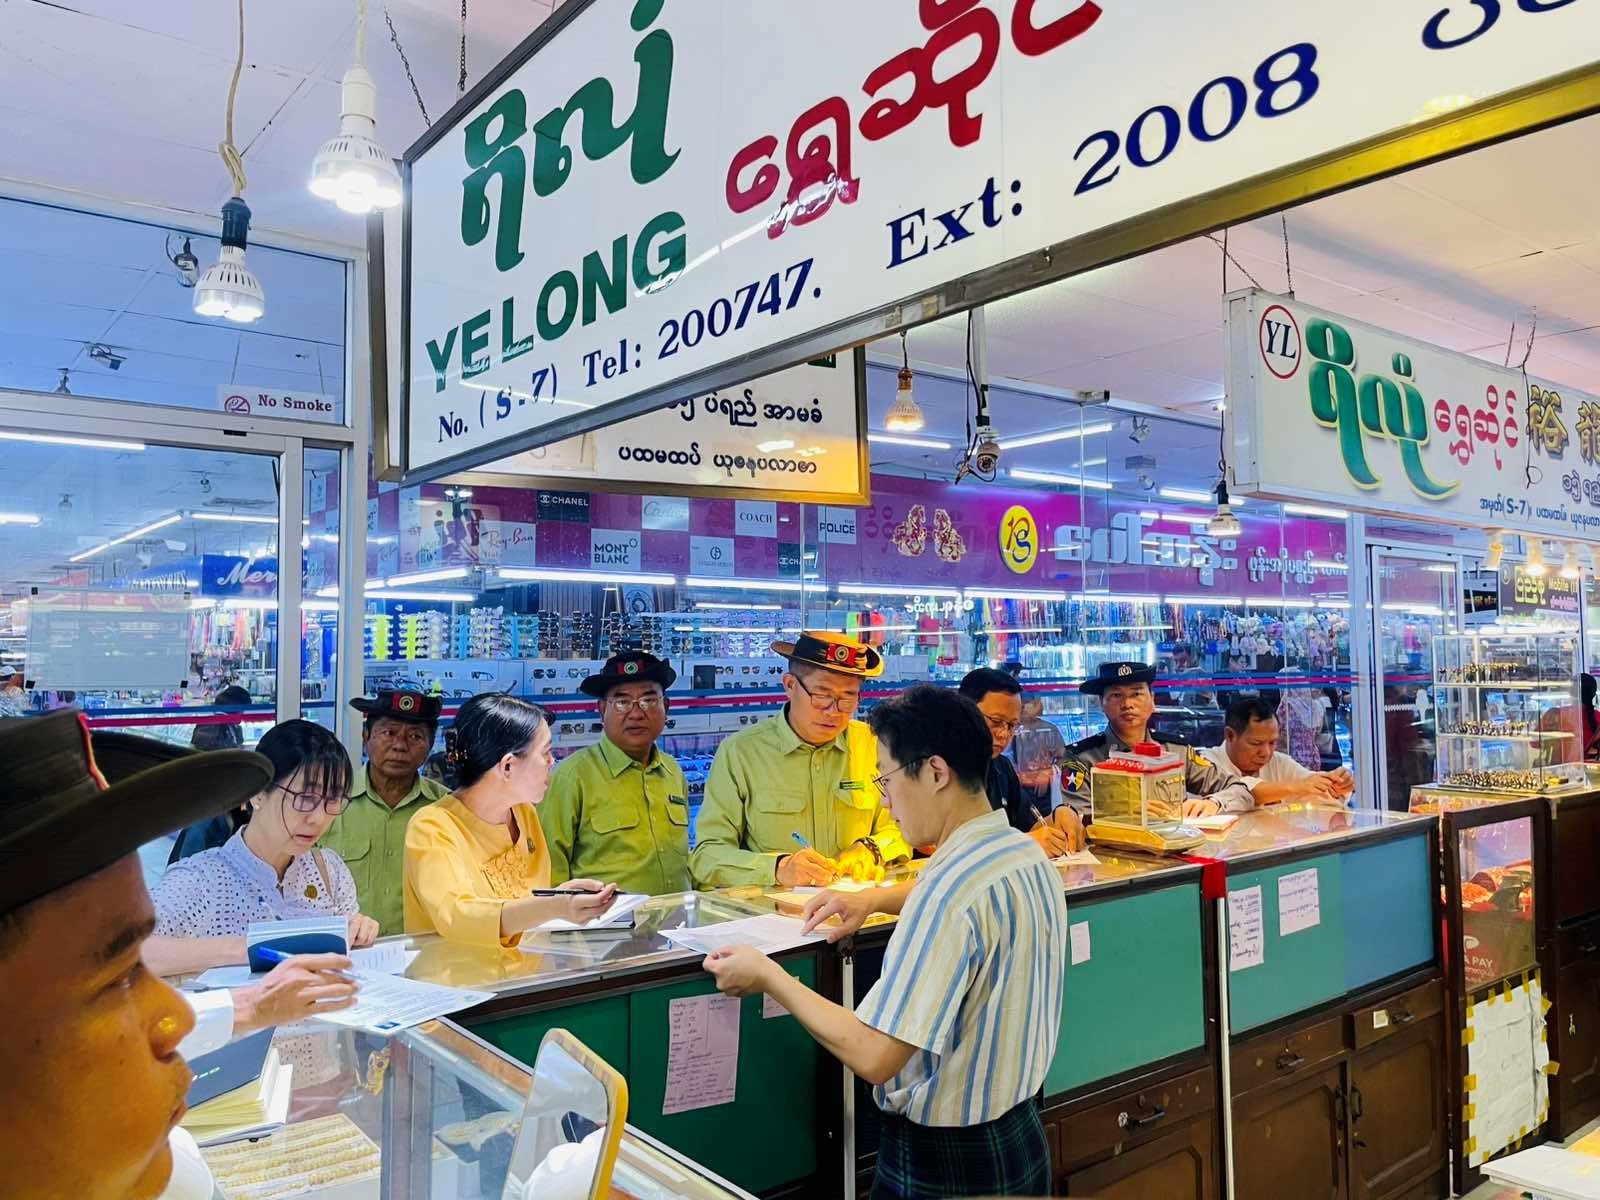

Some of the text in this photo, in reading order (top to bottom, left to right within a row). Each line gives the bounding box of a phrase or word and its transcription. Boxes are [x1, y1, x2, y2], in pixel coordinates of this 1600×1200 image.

[438, 411, 468, 442] No.
[583, 335, 642, 388] Tel:
[657, 258, 821, 360] 200747.
[886, 177, 1022, 268] Ext:
[1073, 42, 1319, 196] 2008
[426, 211, 687, 393] YELONG
[1264, 320, 1297, 360] YL
[257, 394, 333, 412] No Smoke
[763, 398, 823, 424] အာမခံ
[618, 442, 701, 466] ပထမထပ်
[552, 496, 589, 506] CHANEL
[739, 512, 772, 523] COACH
[819, 523, 855, 534] POLICE
[594, 543, 629, 553] MONT
[594, 553, 630, 564] BLANC
